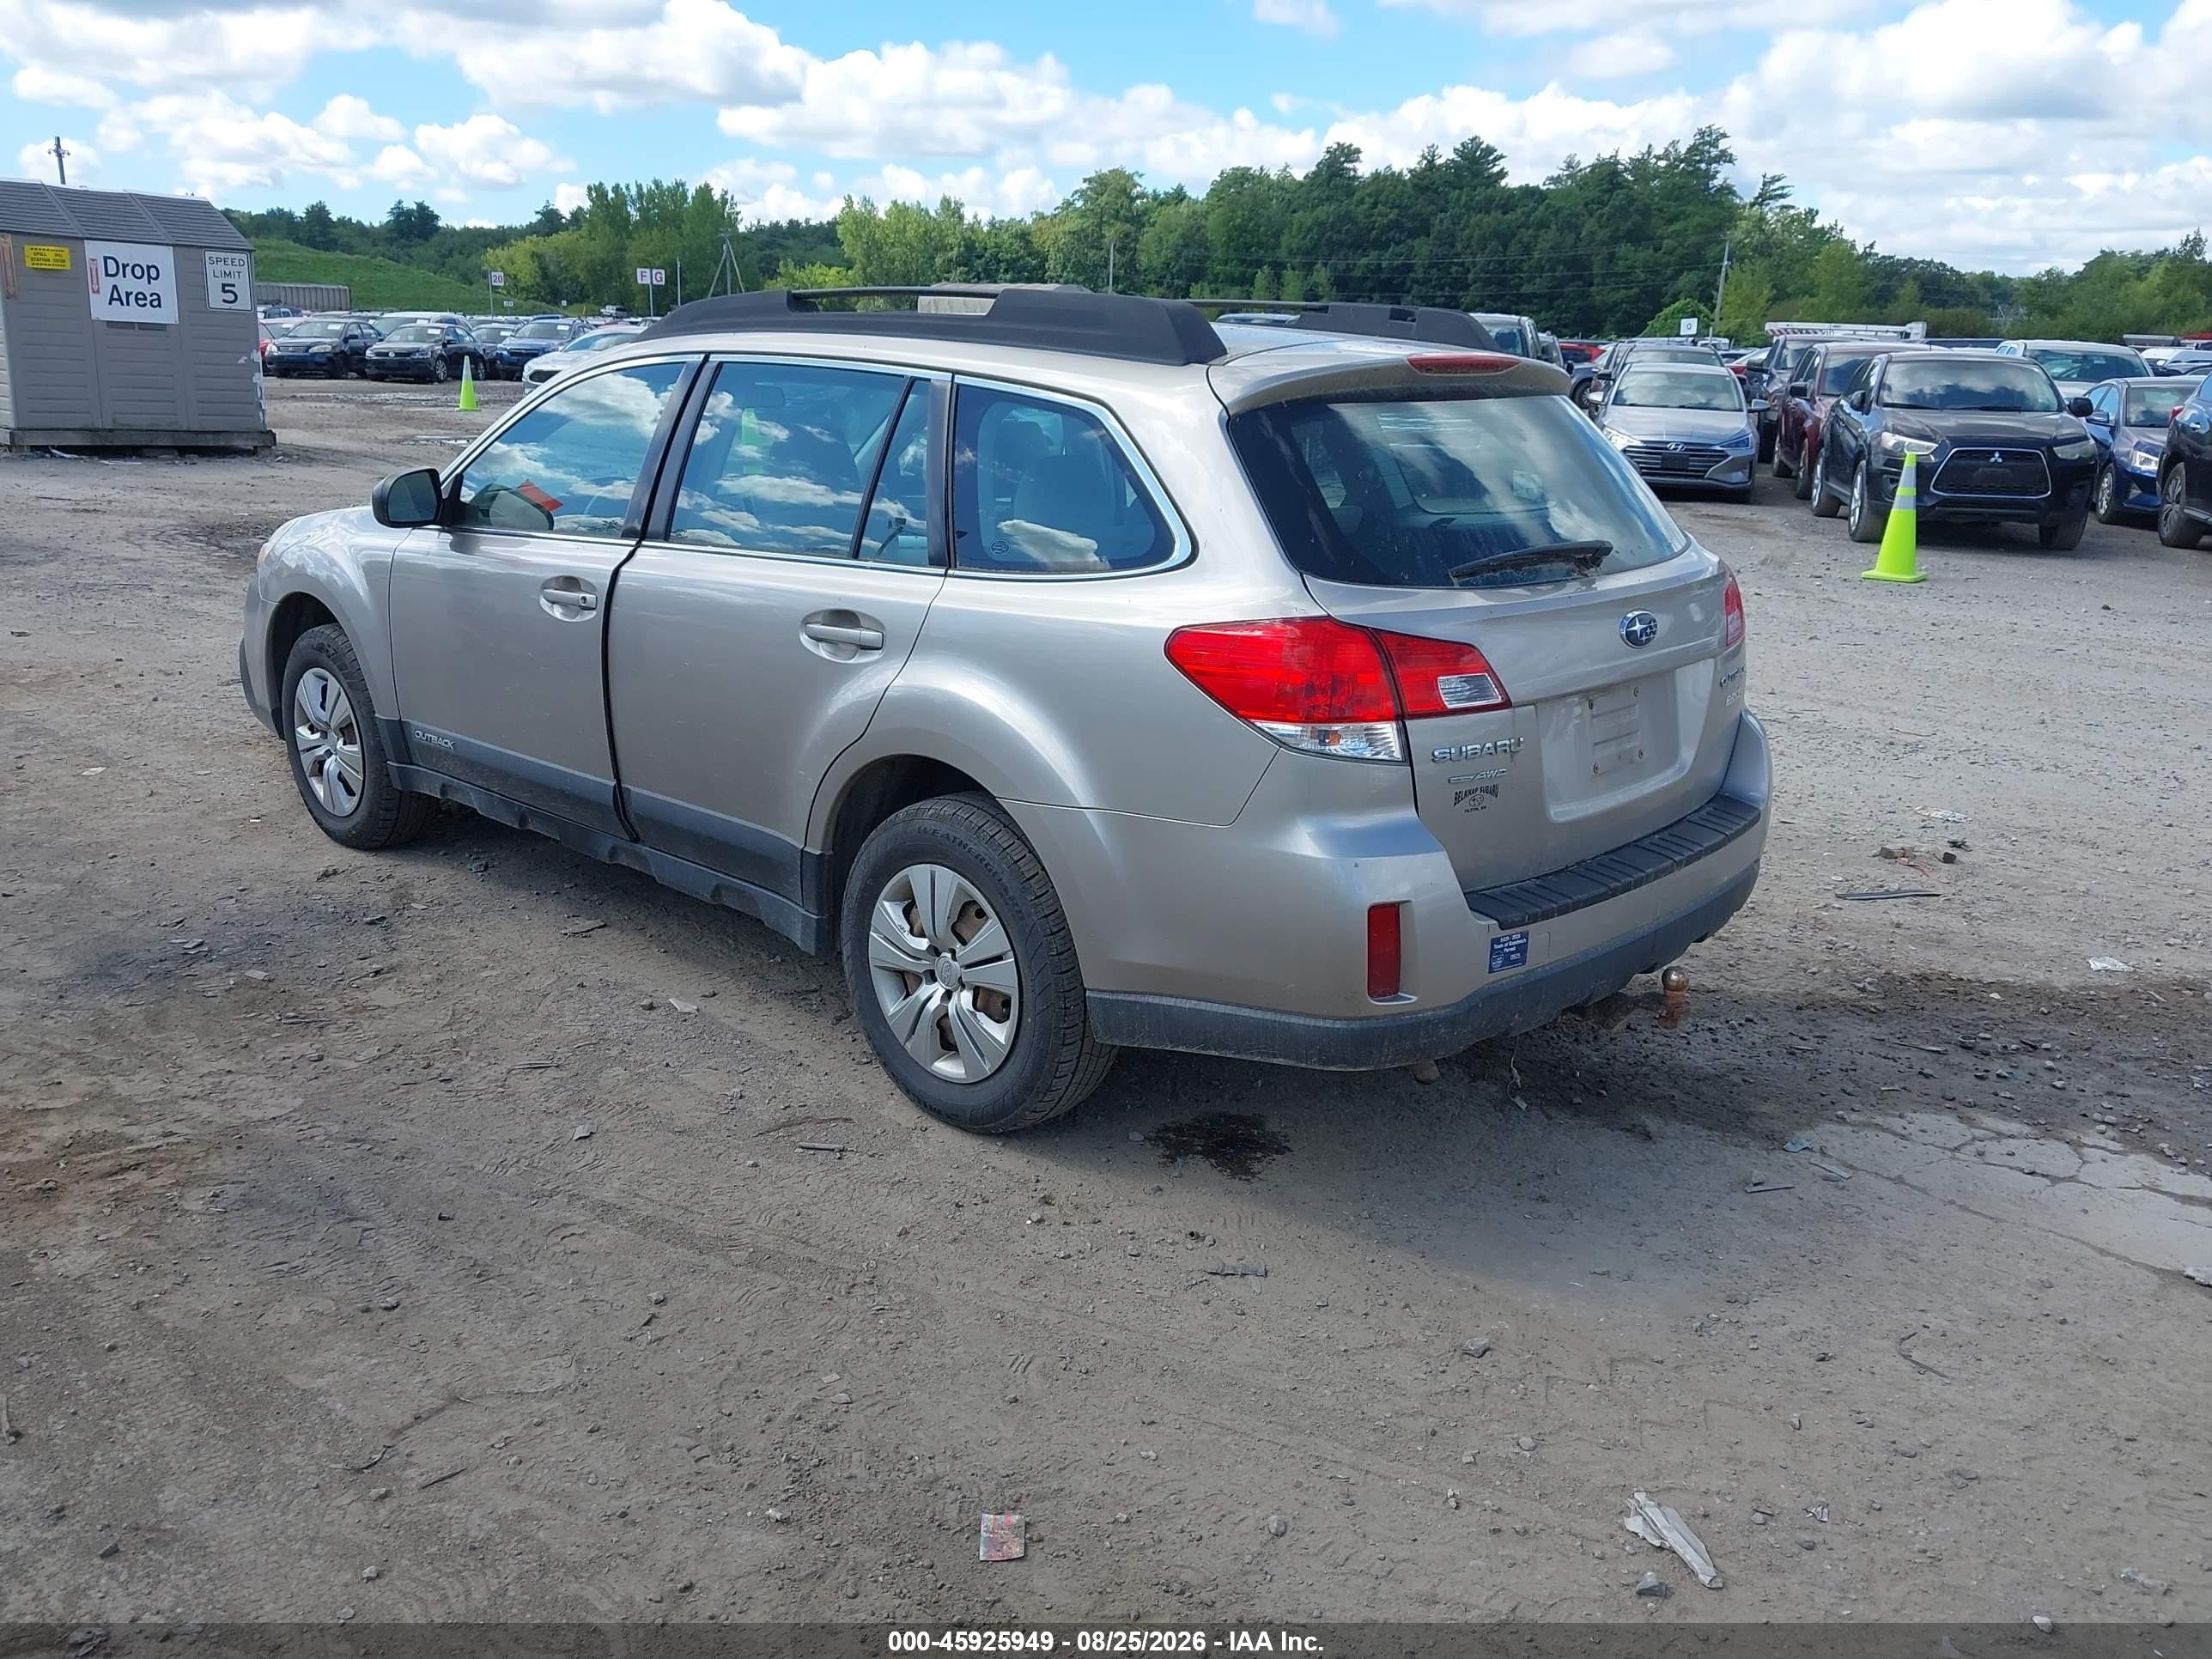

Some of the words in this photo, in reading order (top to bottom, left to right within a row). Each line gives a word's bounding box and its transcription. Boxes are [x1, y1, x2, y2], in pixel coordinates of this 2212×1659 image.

[103, 255, 161, 285] Drop
[208, 256, 246, 267] SPEED
[212, 270, 242, 280] LIMIT
[492, 275, 503, 283] 20
[641, 270, 647, 282] F
[654, 271, 663, 283] G
[108, 284, 162, 308] Area
[221, 283, 238, 304] 5
[415, 730, 454, 750] OUTBACK
[1431, 737, 1524, 763] SUBARU
[1453, 787, 1478, 807] BELKNAP
[1479, 783, 1499, 799] SUBARU
